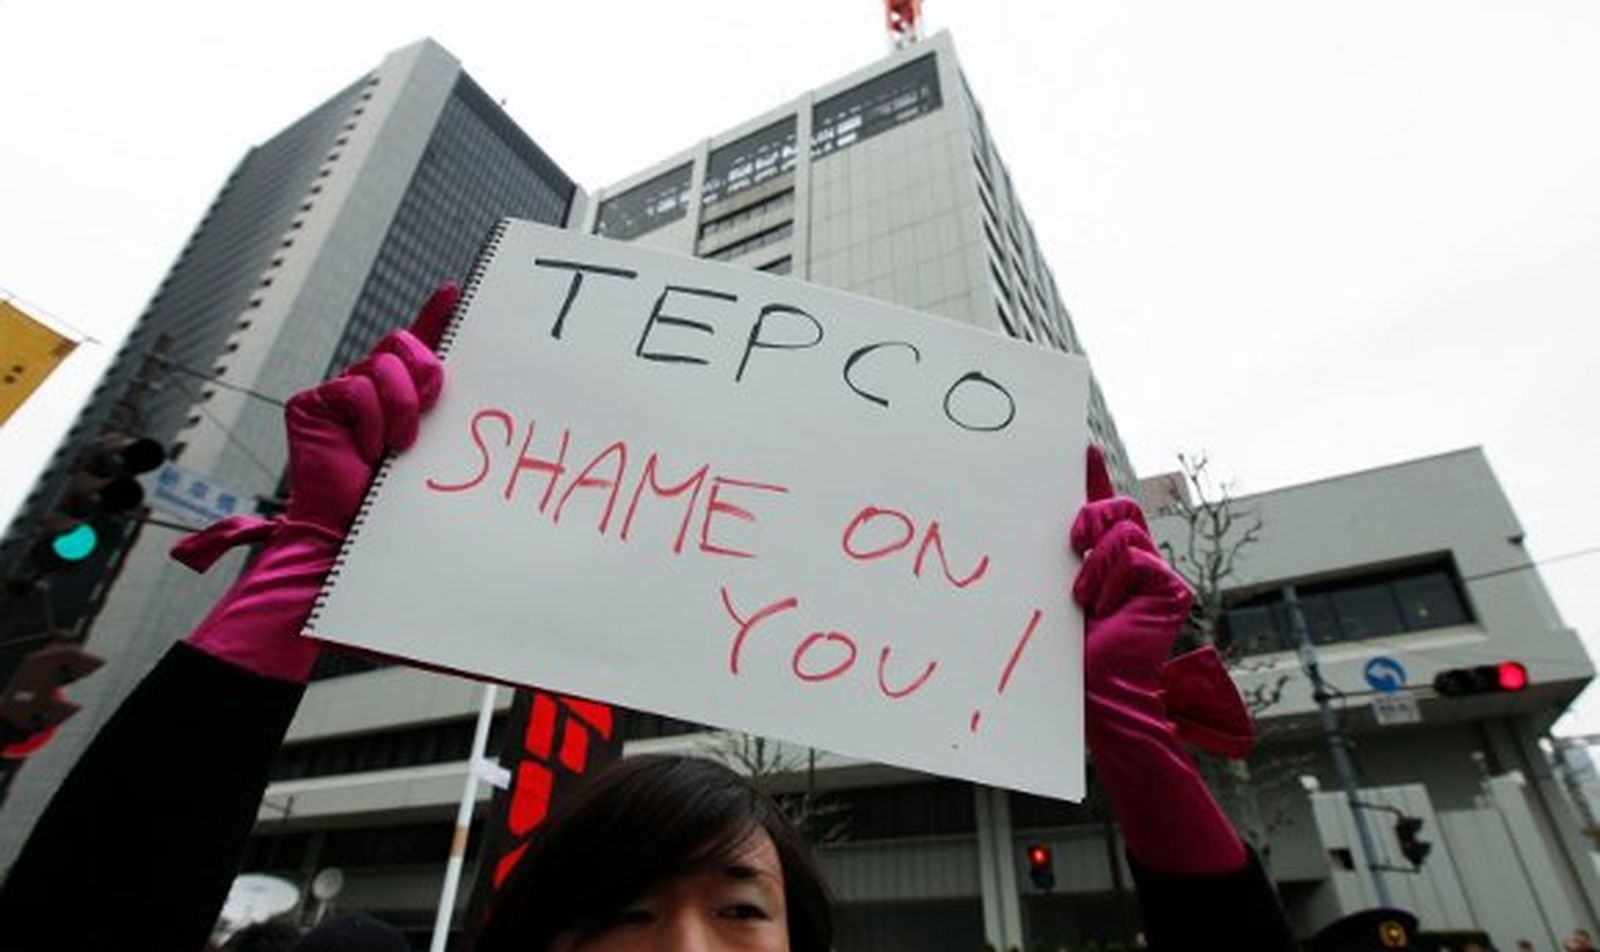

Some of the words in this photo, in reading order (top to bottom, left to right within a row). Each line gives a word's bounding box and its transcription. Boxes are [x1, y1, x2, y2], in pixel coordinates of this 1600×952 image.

[535, 258, 1017, 432] TEPCO
[426, 408, 789, 558] SHAME
[842, 506, 990, 588] ON
